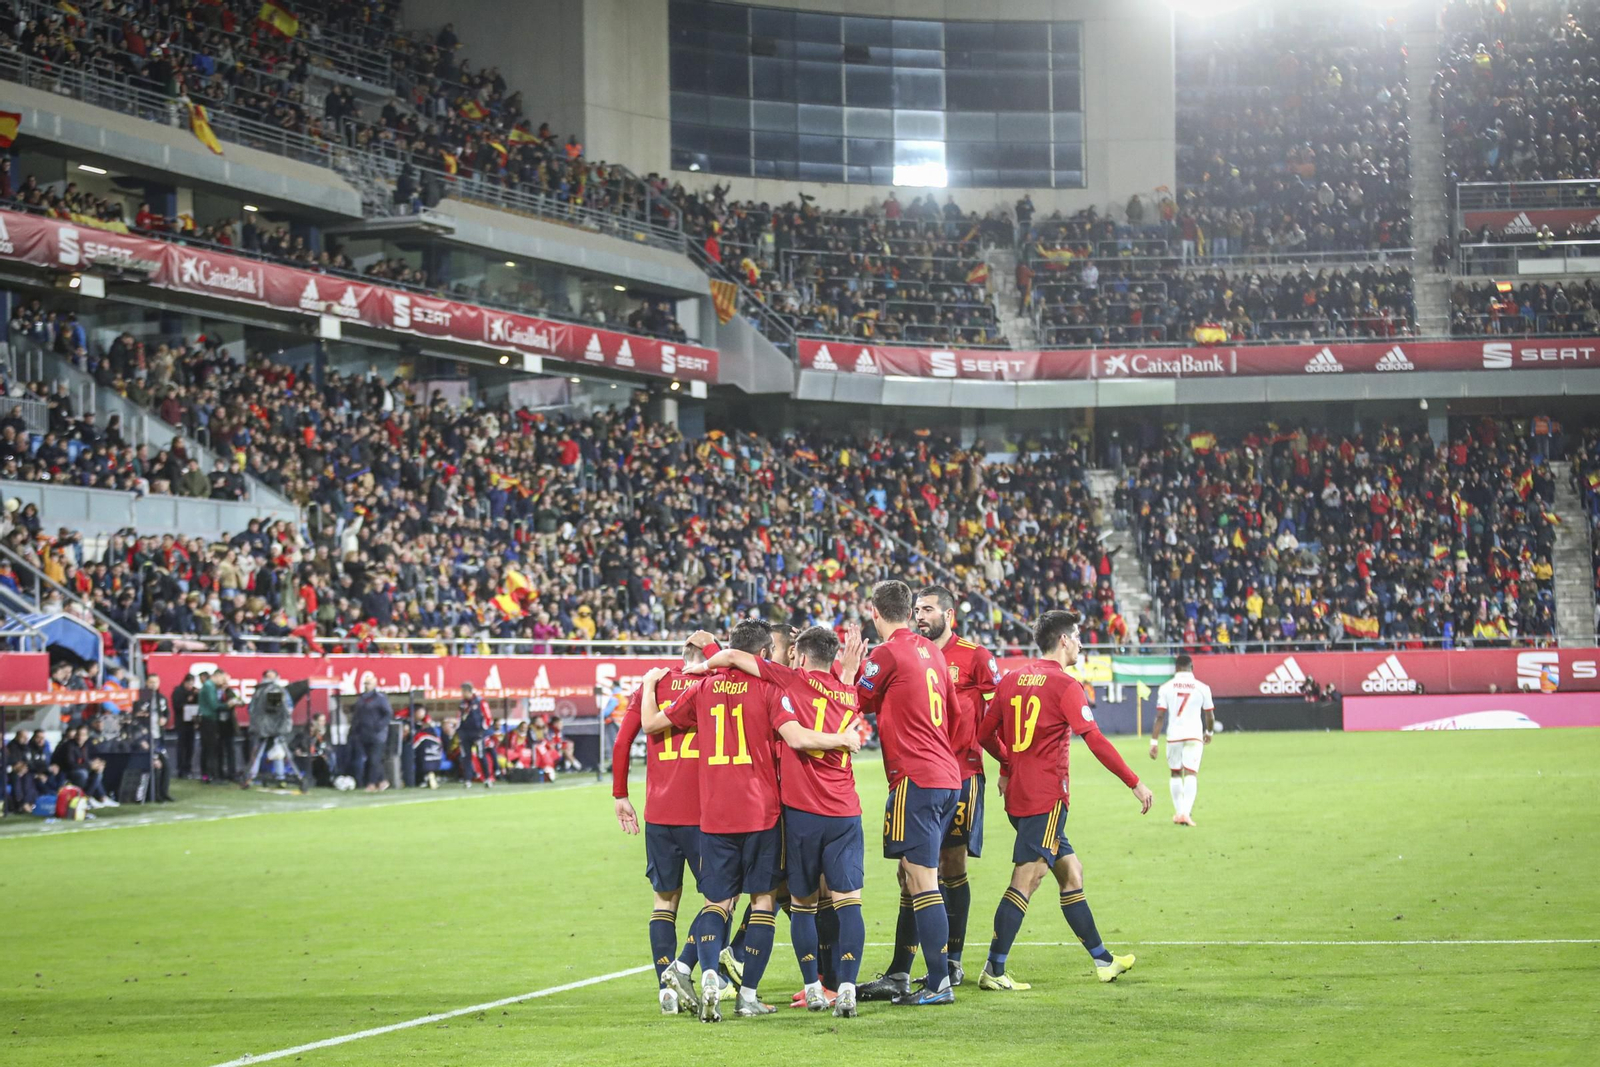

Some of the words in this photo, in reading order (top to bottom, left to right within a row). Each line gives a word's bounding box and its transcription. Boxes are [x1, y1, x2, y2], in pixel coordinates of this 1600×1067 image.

[1521, 347, 1596, 361] SEAT
[962, 359, 1025, 373] SEAT
[1131, 353, 1225, 374] CaixaBank
[1304, 363, 1344, 373] adidas
[1375, 362, 1415, 372] adidas
[1361, 679, 1417, 692] adidas
[926, 667, 943, 727] 6
[1176, 692, 1191, 717] 7
[708, 703, 753, 765] 11
[954, 801, 966, 825] 3
